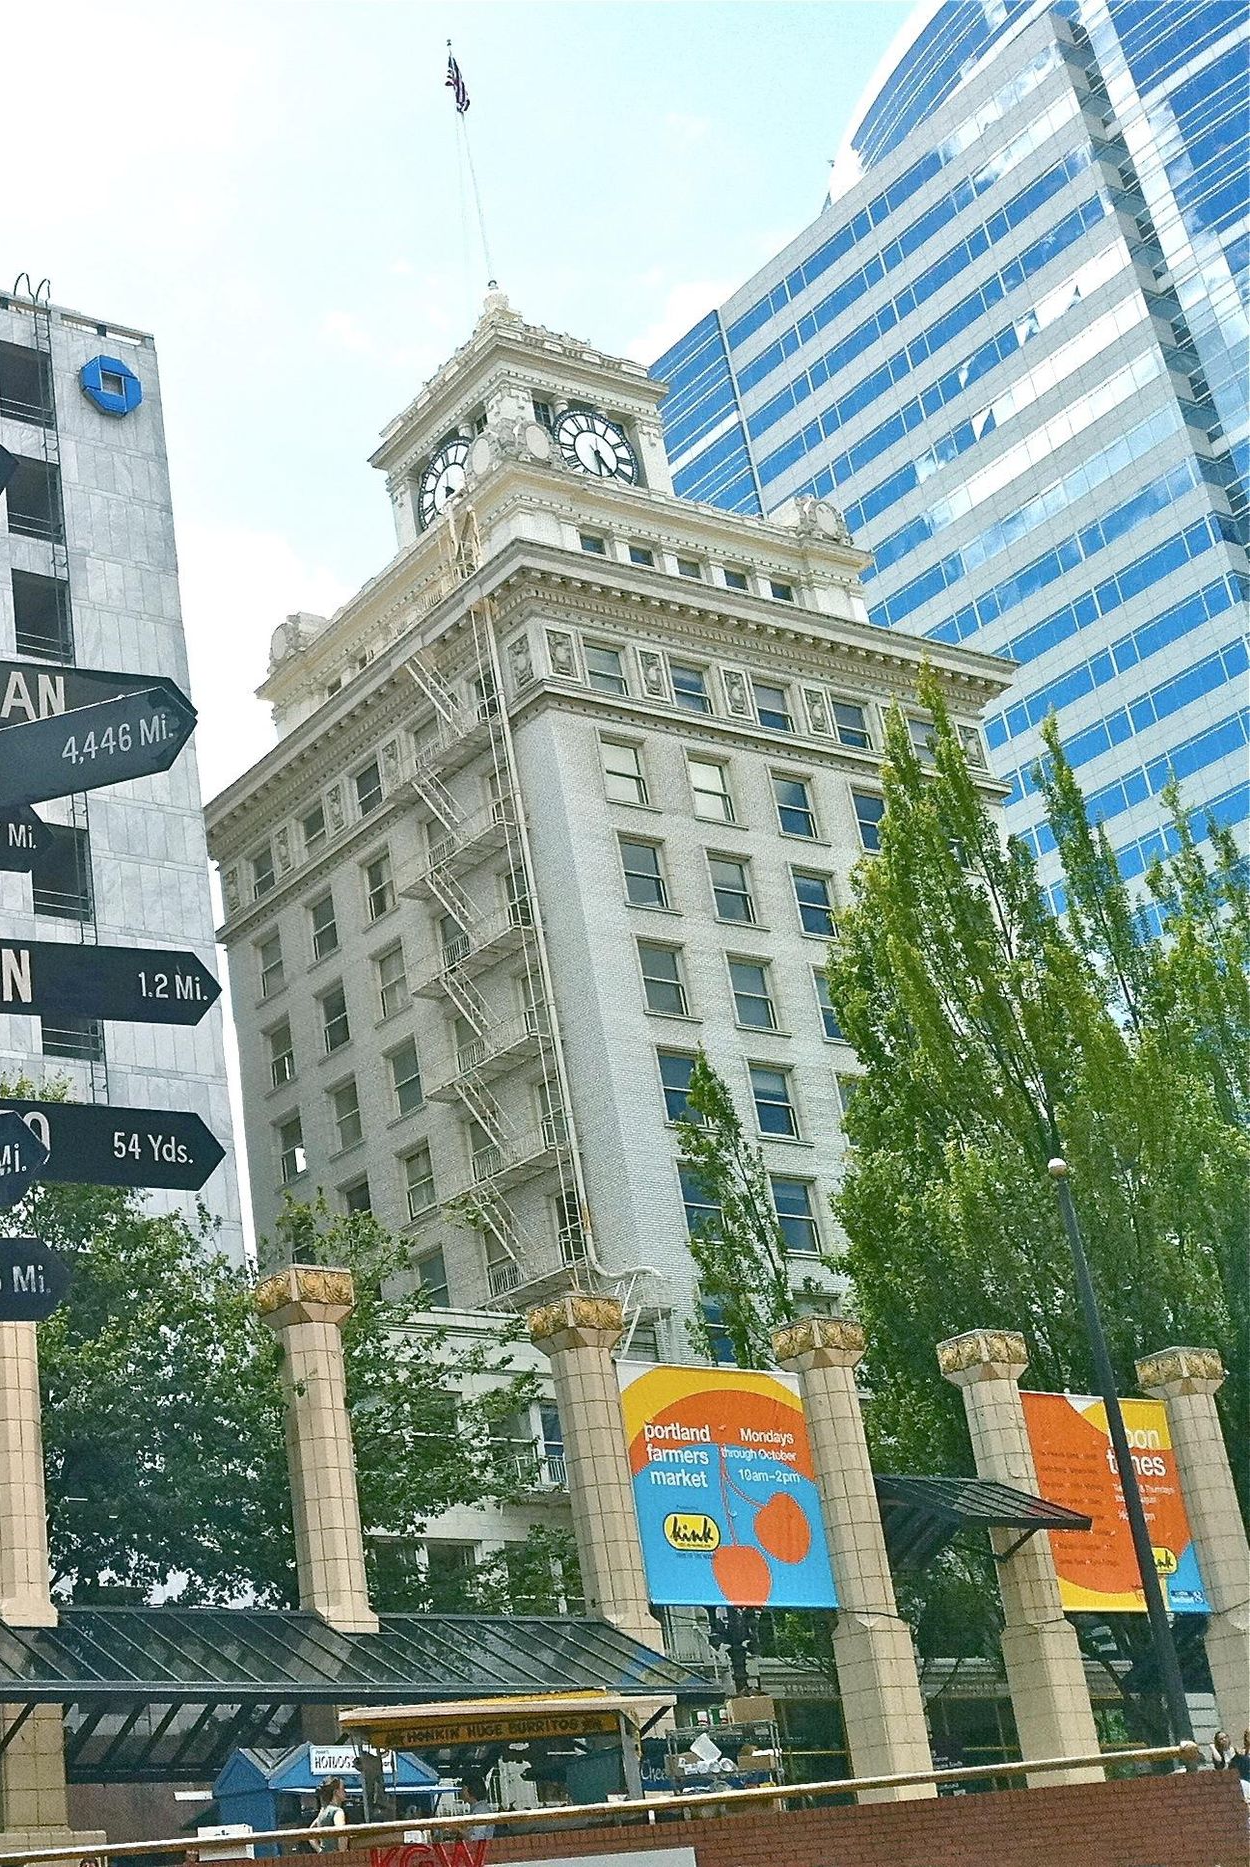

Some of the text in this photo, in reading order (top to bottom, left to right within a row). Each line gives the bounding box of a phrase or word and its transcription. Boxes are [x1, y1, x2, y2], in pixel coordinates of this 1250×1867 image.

[61, 723, 132, 765] 4,446
[139, 713, 174, 746] Mi.
[8, 823, 38, 850] Mi.
[138, 971, 169, 999] 1.2
[174, 974, 208, 1001] Mi.
[113, 1131, 141, 1157] 54
[147, 1133, 194, 1165] Yds.
[12, 1264, 51, 1293] Mi.
[644, 1423, 711, 1442] portland
[739, 1428, 794, 1446] Mondays
[646, 1444, 709, 1465] farmers
[721, 1447, 797, 1462] through October
[650, 1469, 708, 1488] market
[669, 1516, 714, 1543] kink
[467, 1723, 502, 1737] HUGE
[509, 1719, 579, 1735] BURRITOS
